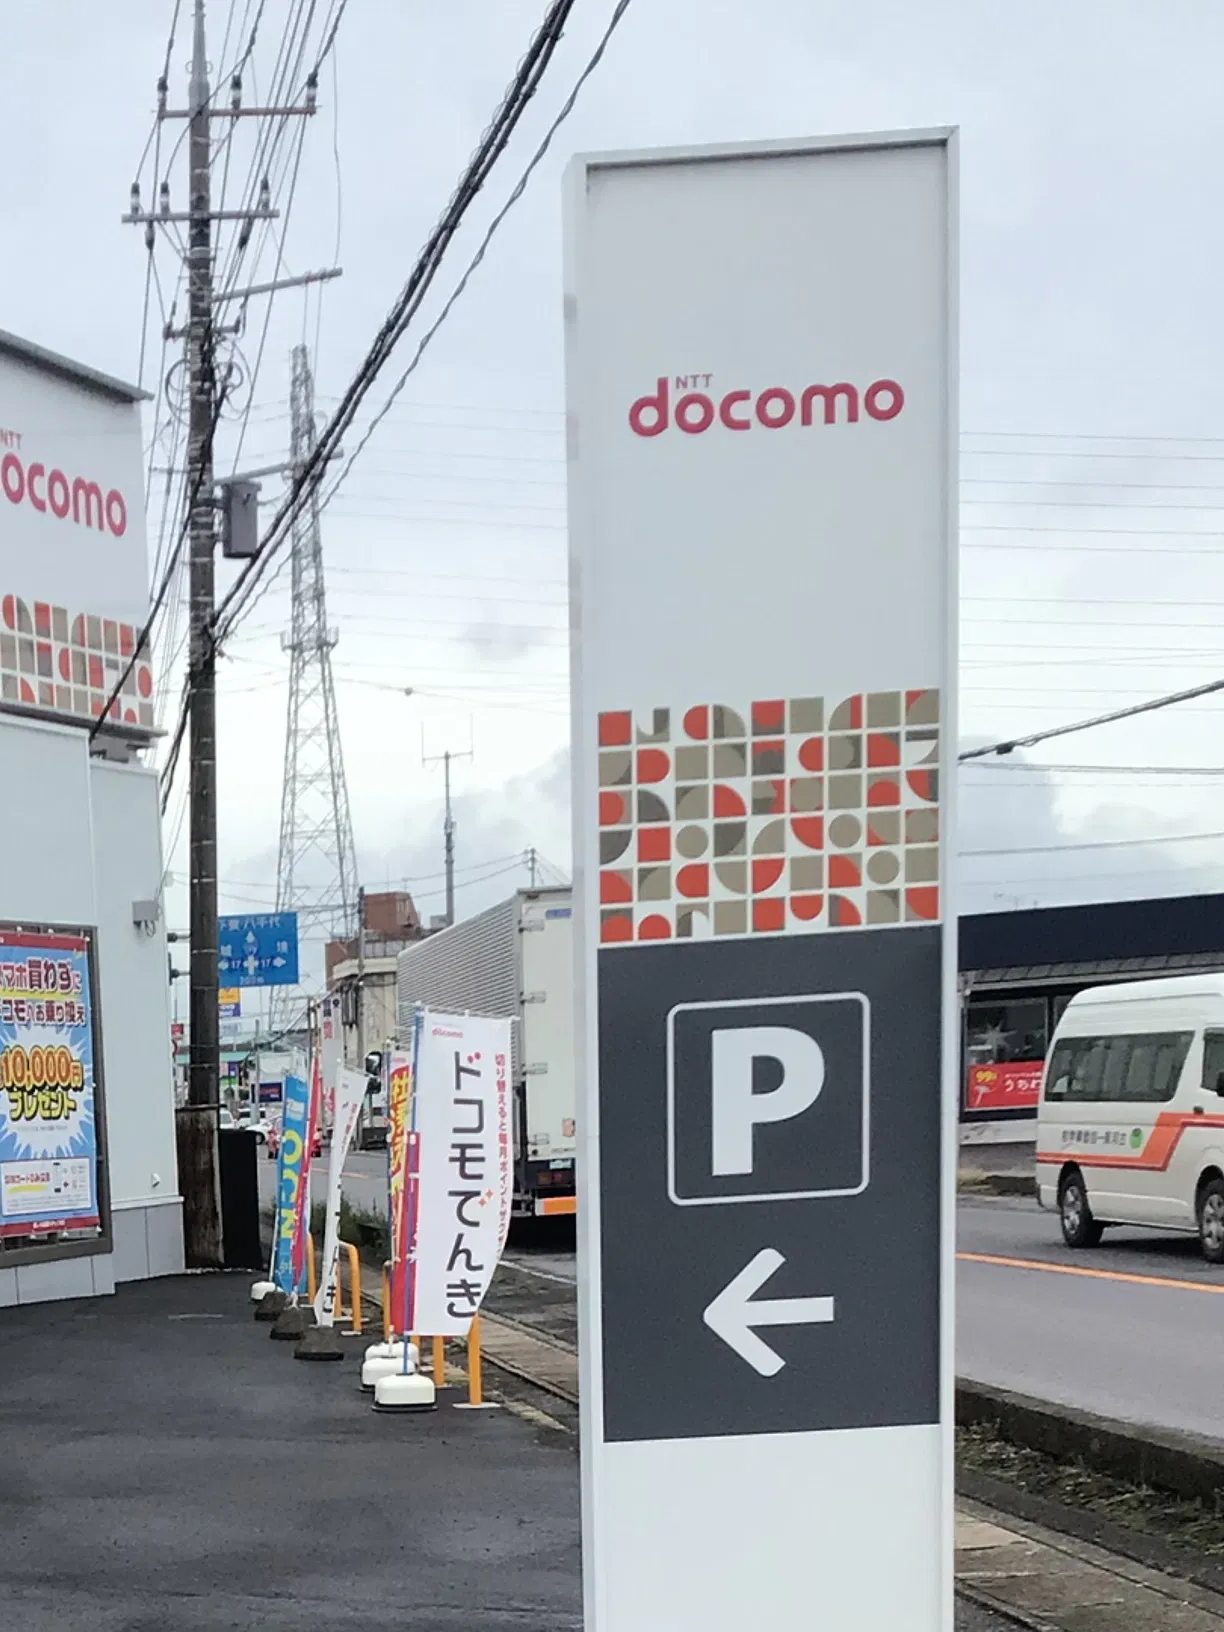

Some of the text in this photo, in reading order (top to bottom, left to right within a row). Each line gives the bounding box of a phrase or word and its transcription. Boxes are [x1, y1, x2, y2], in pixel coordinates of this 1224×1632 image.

[675, 373, 713, 390] NTT
[629, 377, 905, 437] docomo
[0, 428, 22, 451] NTT
[9, 1091, 76, 1121] プレゼント
[712, 1026, 825, 1176] P
